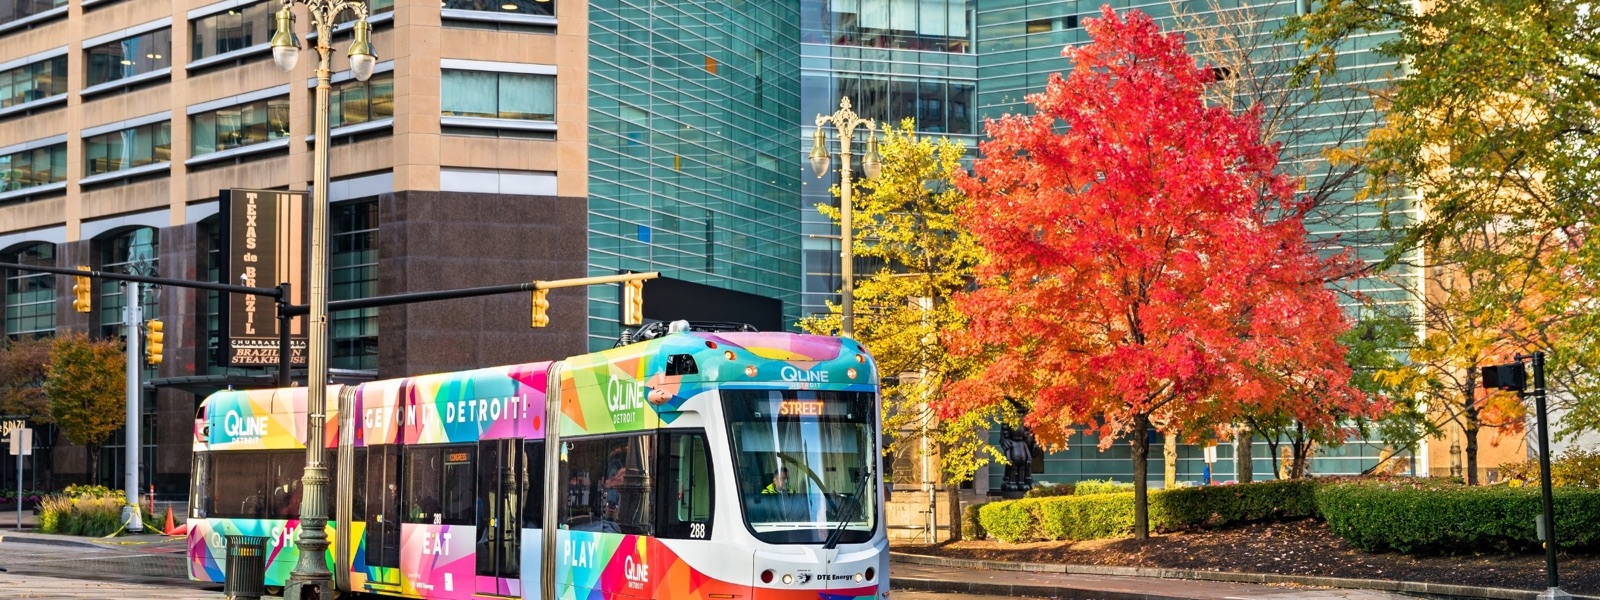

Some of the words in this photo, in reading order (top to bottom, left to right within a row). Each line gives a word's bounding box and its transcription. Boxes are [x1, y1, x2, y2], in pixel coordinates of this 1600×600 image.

[246, 192, 257, 249] TEXAS
[243, 253, 258, 263] de
[245, 266, 256, 335] BRAZIL
[231, 355, 306, 364] STEAKHSE
[236, 348, 301, 357] BRAZILN
[781, 366, 829, 382] QLINE
[607, 374, 644, 412] QLINE
[396, 405, 416, 427] ON
[446, 393, 527, 423] DETROIT!
[613, 412, 636, 424] DETROIT
[781, 401, 824, 415] STREET
[225, 410, 268, 436] QLINE
[232, 436, 260, 444] DETROIT
[271, 527, 303, 547] SH
[690, 523, 706, 539] 288
[423, 532, 452, 555] EAT
[564, 540, 596, 568] PLAY
[625, 555, 649, 583] QLINE
